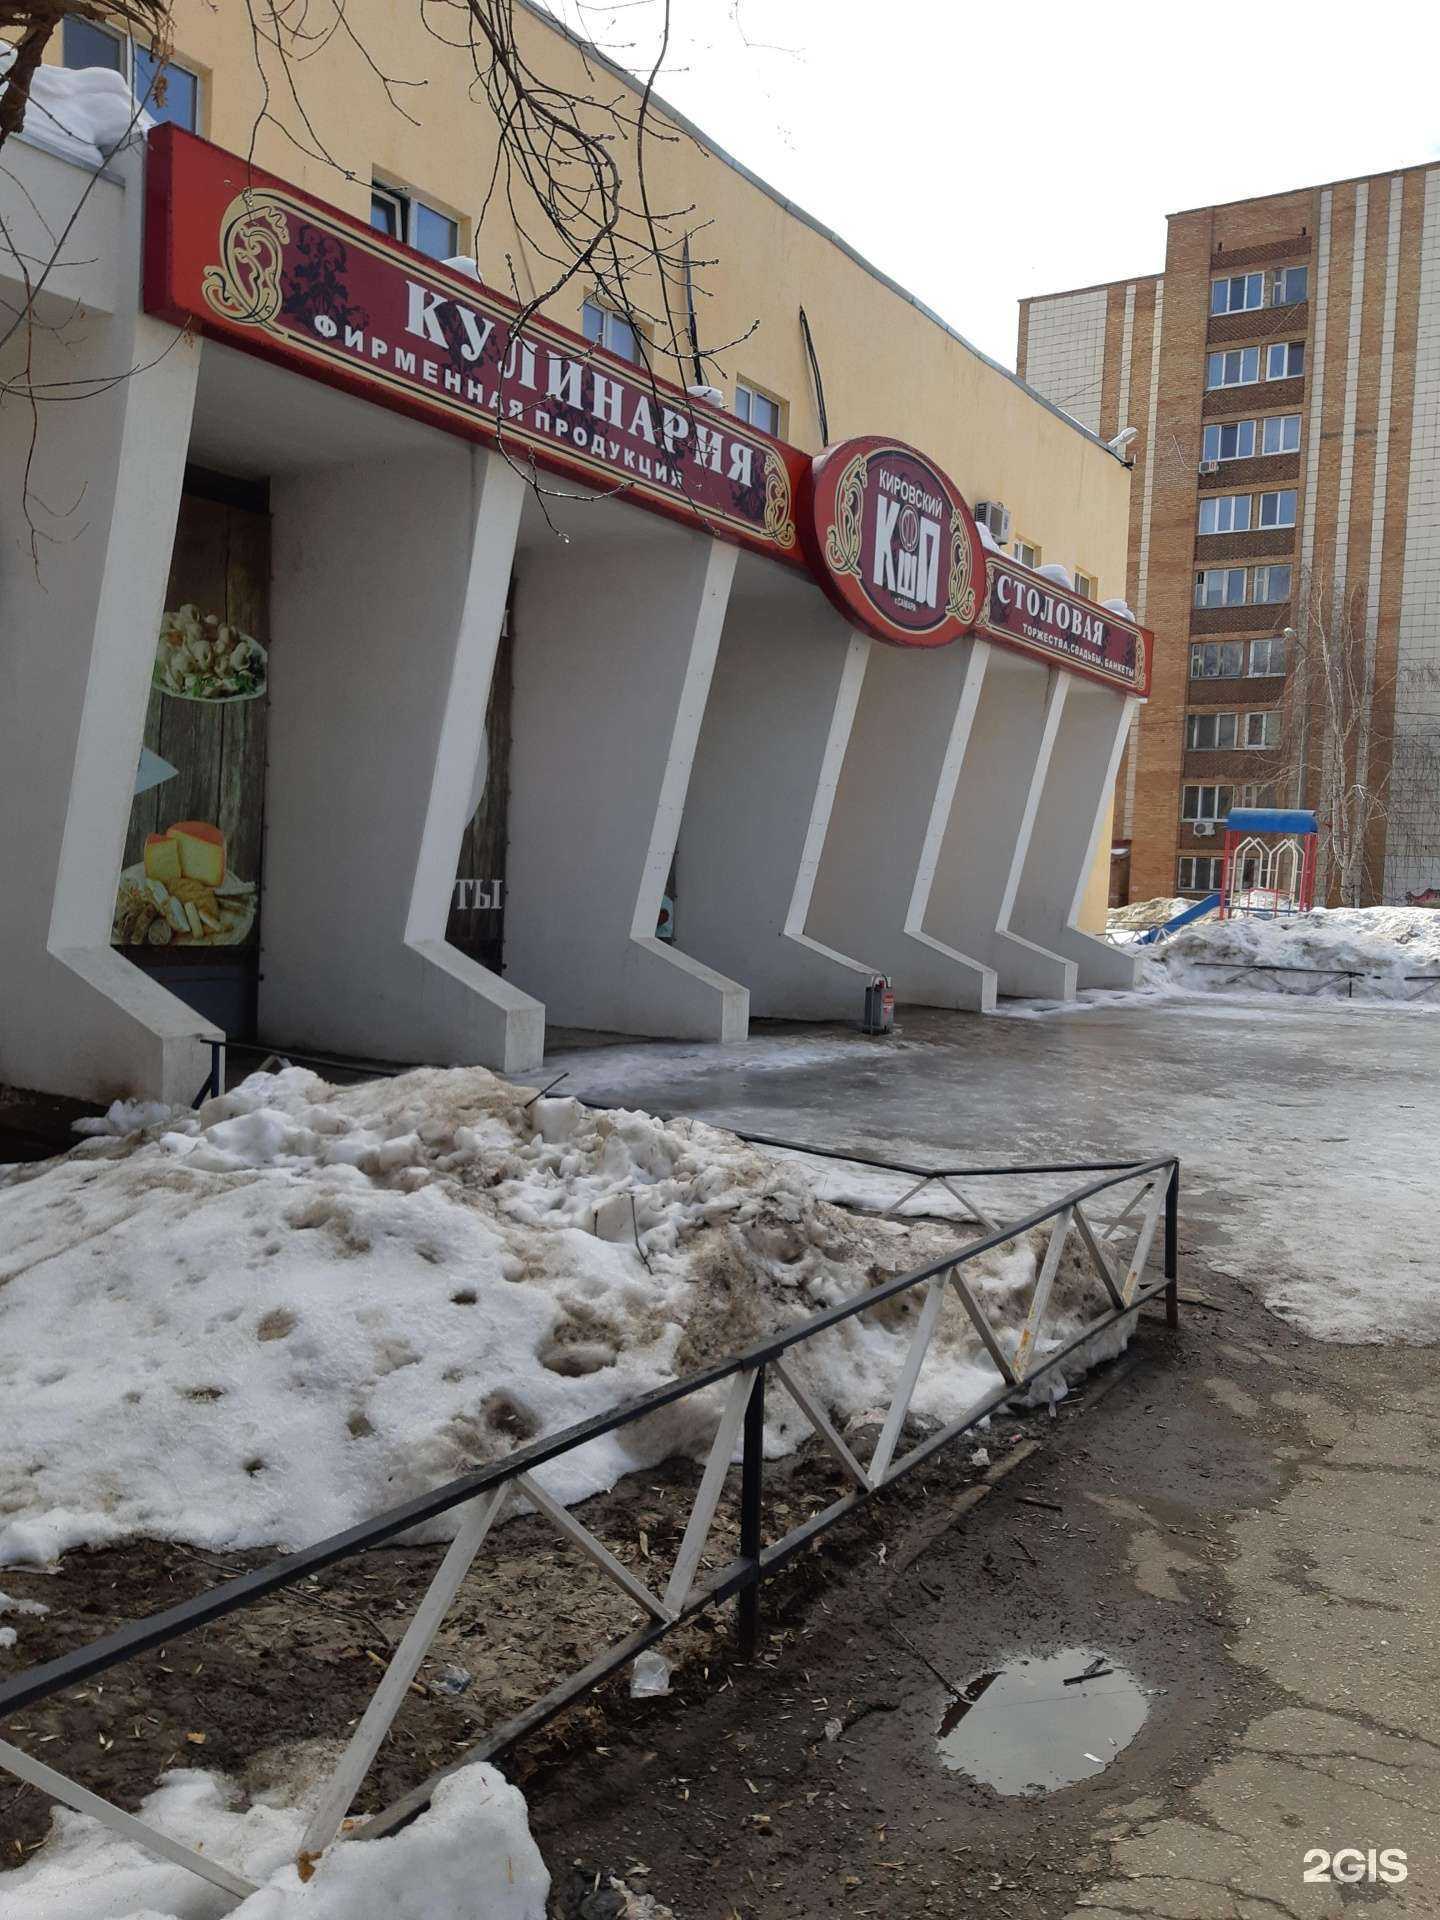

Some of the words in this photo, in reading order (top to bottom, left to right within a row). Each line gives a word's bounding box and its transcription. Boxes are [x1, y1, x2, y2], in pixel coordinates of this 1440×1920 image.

[314, 314, 524, 421] ФИРМЕННАЯ
[535, 411, 684, 489] ПРОДУКЦИЯ
[405, 280, 754, 488] КУЛИНАРИЯ
[879, 469, 943, 519] КИРОВСКИЙ
[997, 575, 1104, 646] СТОЛОВАЯ
[1105, 658, 1135, 677] БАНКЕТЫ
